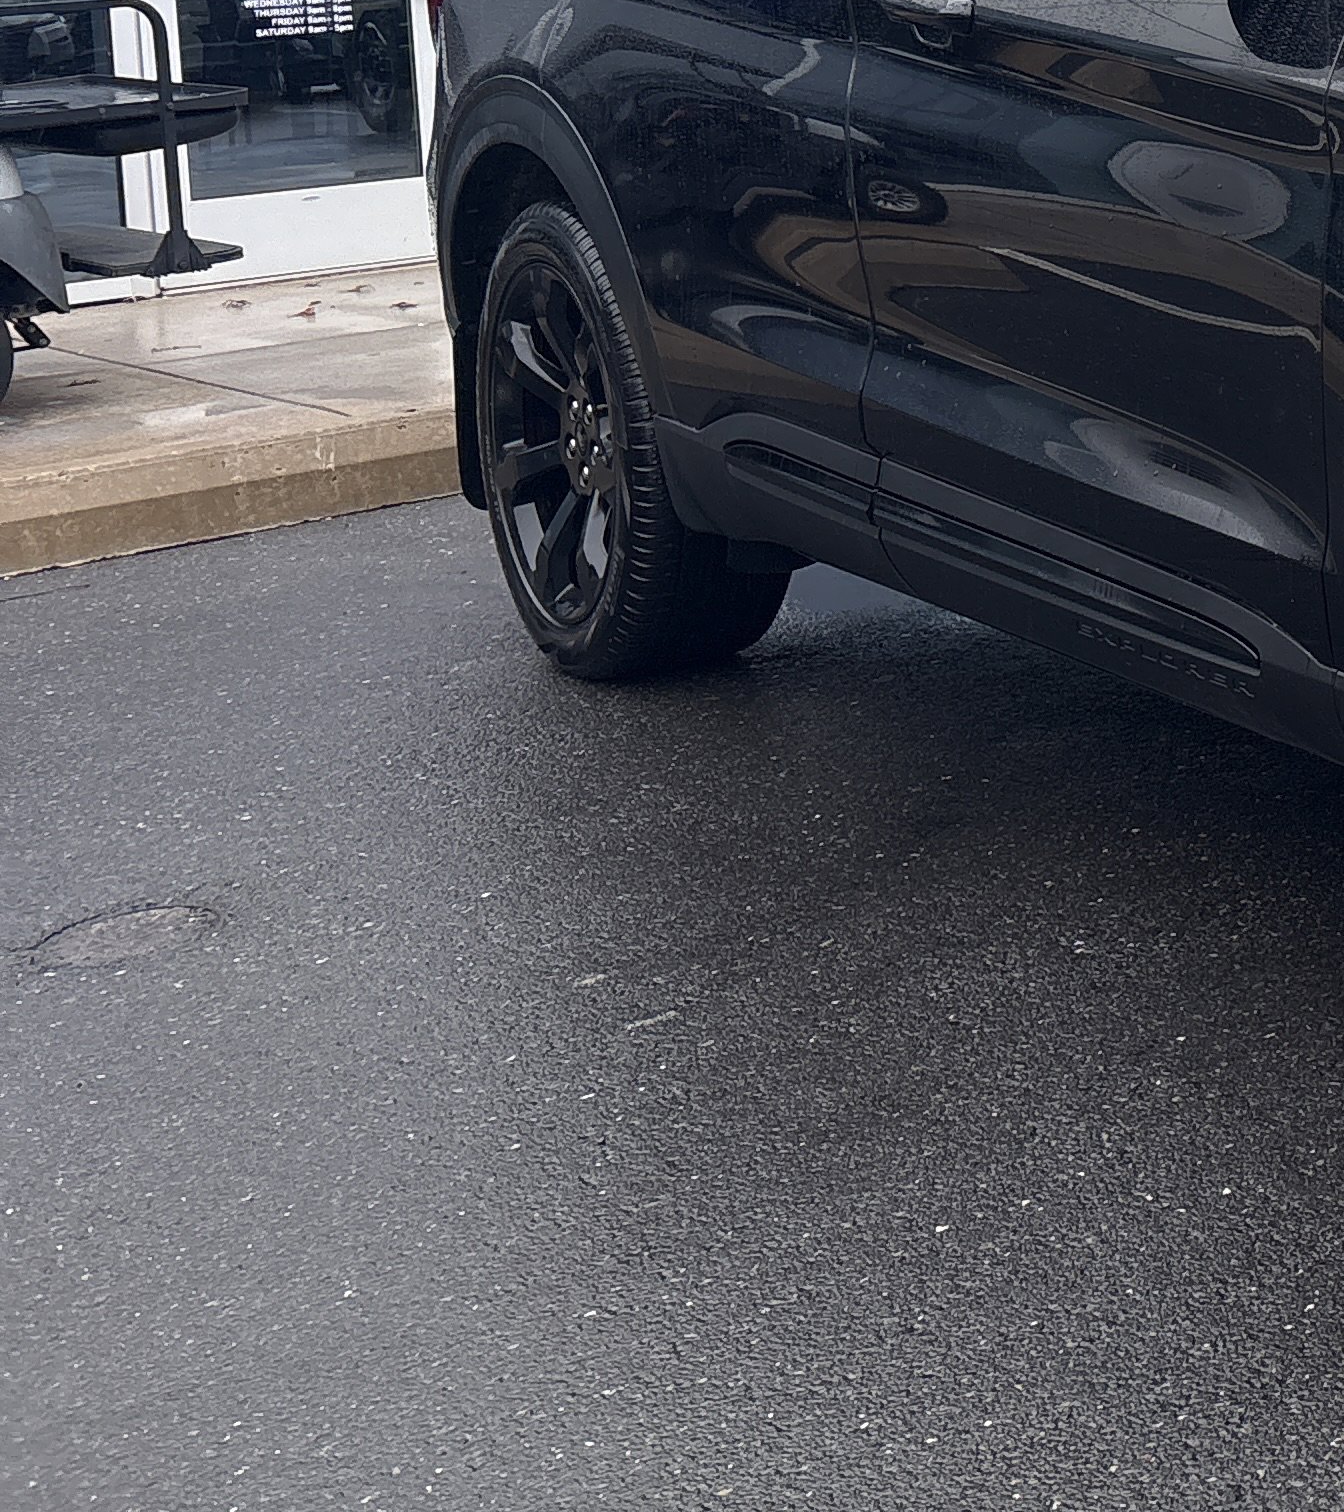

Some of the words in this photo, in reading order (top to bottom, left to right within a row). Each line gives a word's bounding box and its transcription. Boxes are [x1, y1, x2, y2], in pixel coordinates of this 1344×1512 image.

[253, 6, 305, 18] THURSDAY
[271, 16, 306, 26] FRIDAY
[255, 26, 306, 38] SATURDAY
